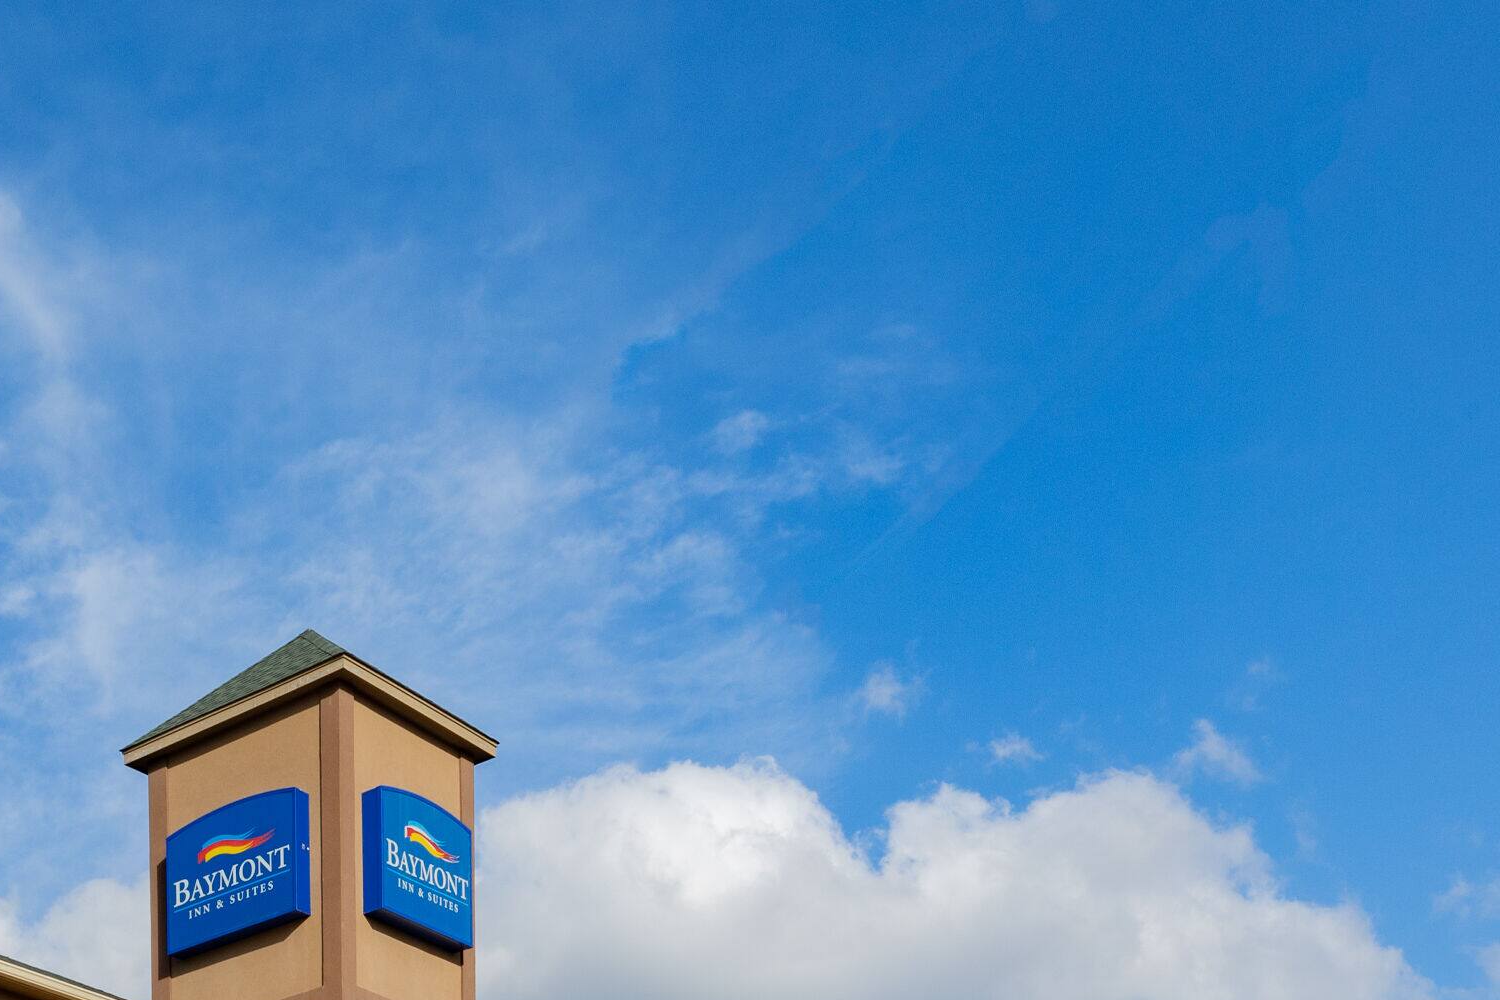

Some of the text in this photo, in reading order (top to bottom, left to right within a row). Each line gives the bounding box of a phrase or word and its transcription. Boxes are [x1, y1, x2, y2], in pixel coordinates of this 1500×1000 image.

[173, 844, 290, 908] BAYMONT
[386, 837, 469, 900] BAYMONT
[188, 880, 274, 920] INN & SUITES
[397, 878, 459, 913] INN & SUITES
